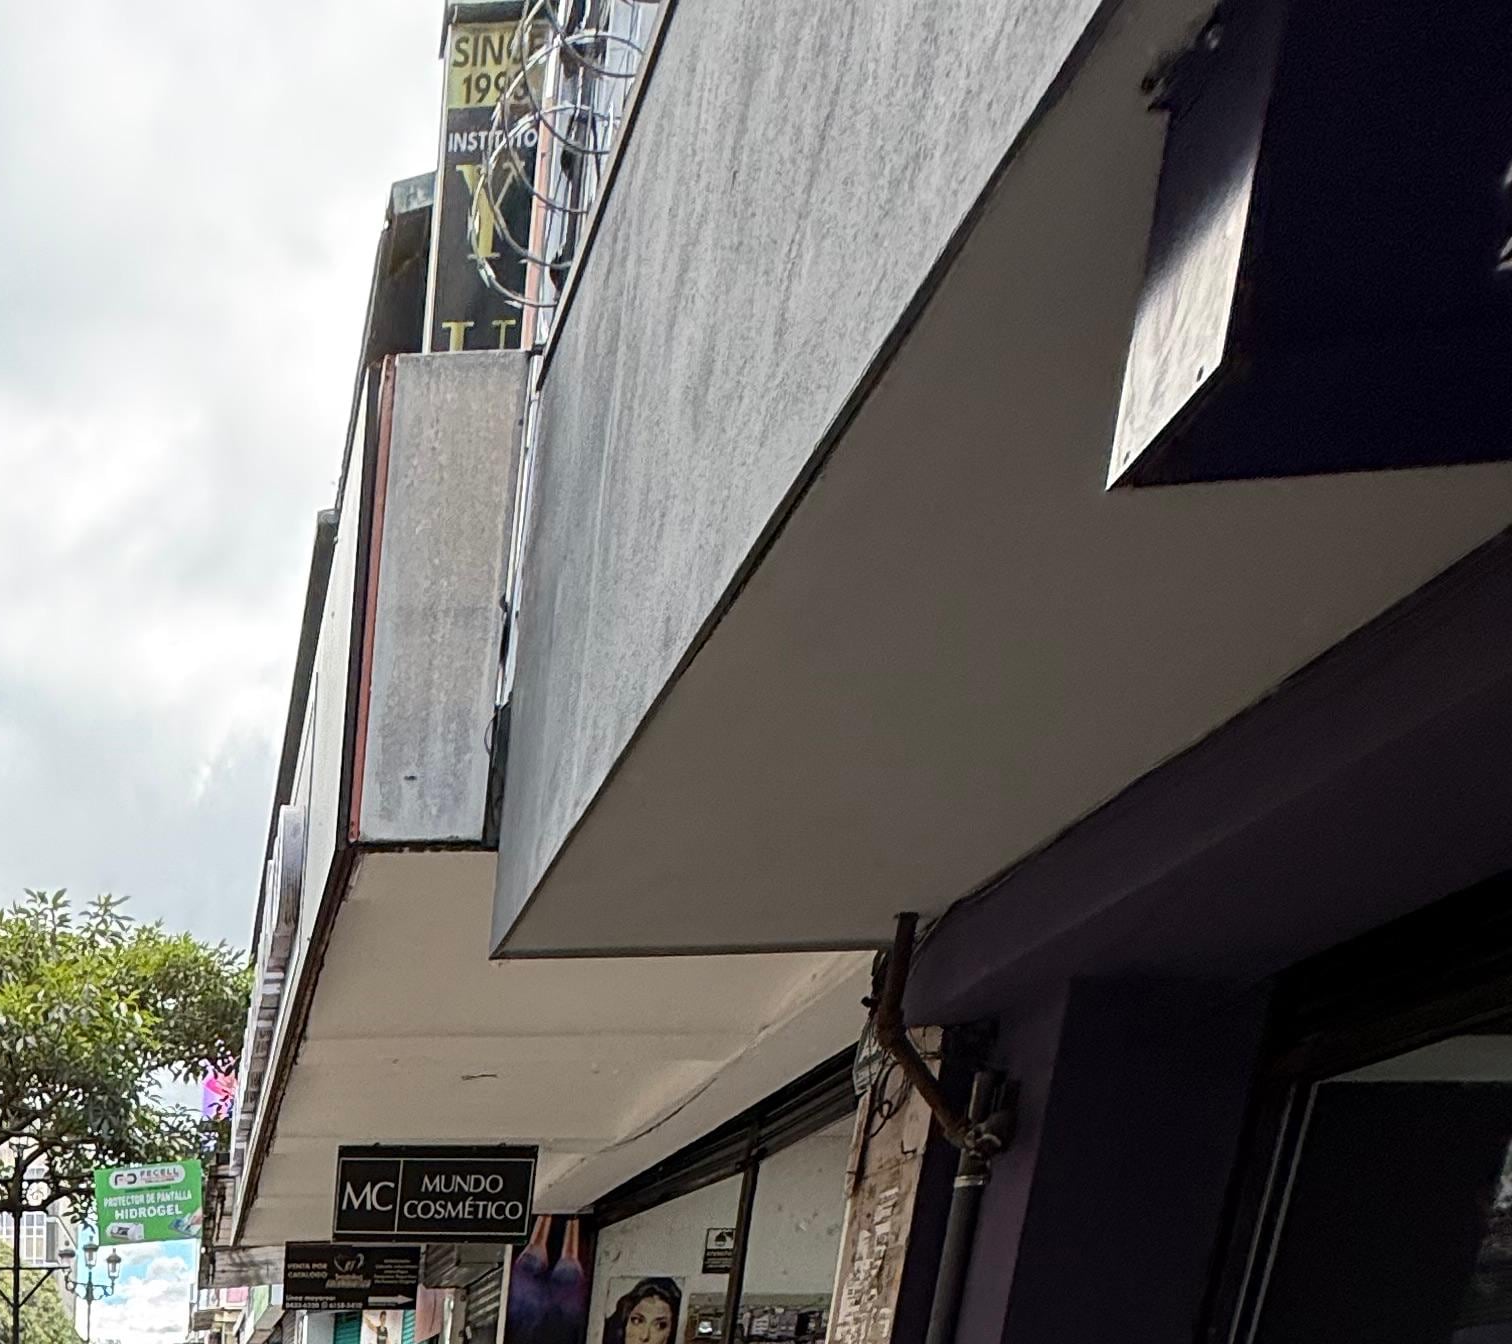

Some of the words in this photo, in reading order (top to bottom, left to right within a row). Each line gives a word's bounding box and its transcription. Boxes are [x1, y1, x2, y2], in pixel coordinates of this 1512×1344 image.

[421, 1174, 504, 1193] MUNDO
[103, 1195, 144, 1207] PROTECTOR
[146, 1193, 155, 1203] DE
[157, 1190, 192, 1202] PANTALLA
[342, 1181, 395, 1211] MC
[114, 1204, 182, 1220] HIDROGEL
[403, 1196, 523, 1219] COSMÉTICO
